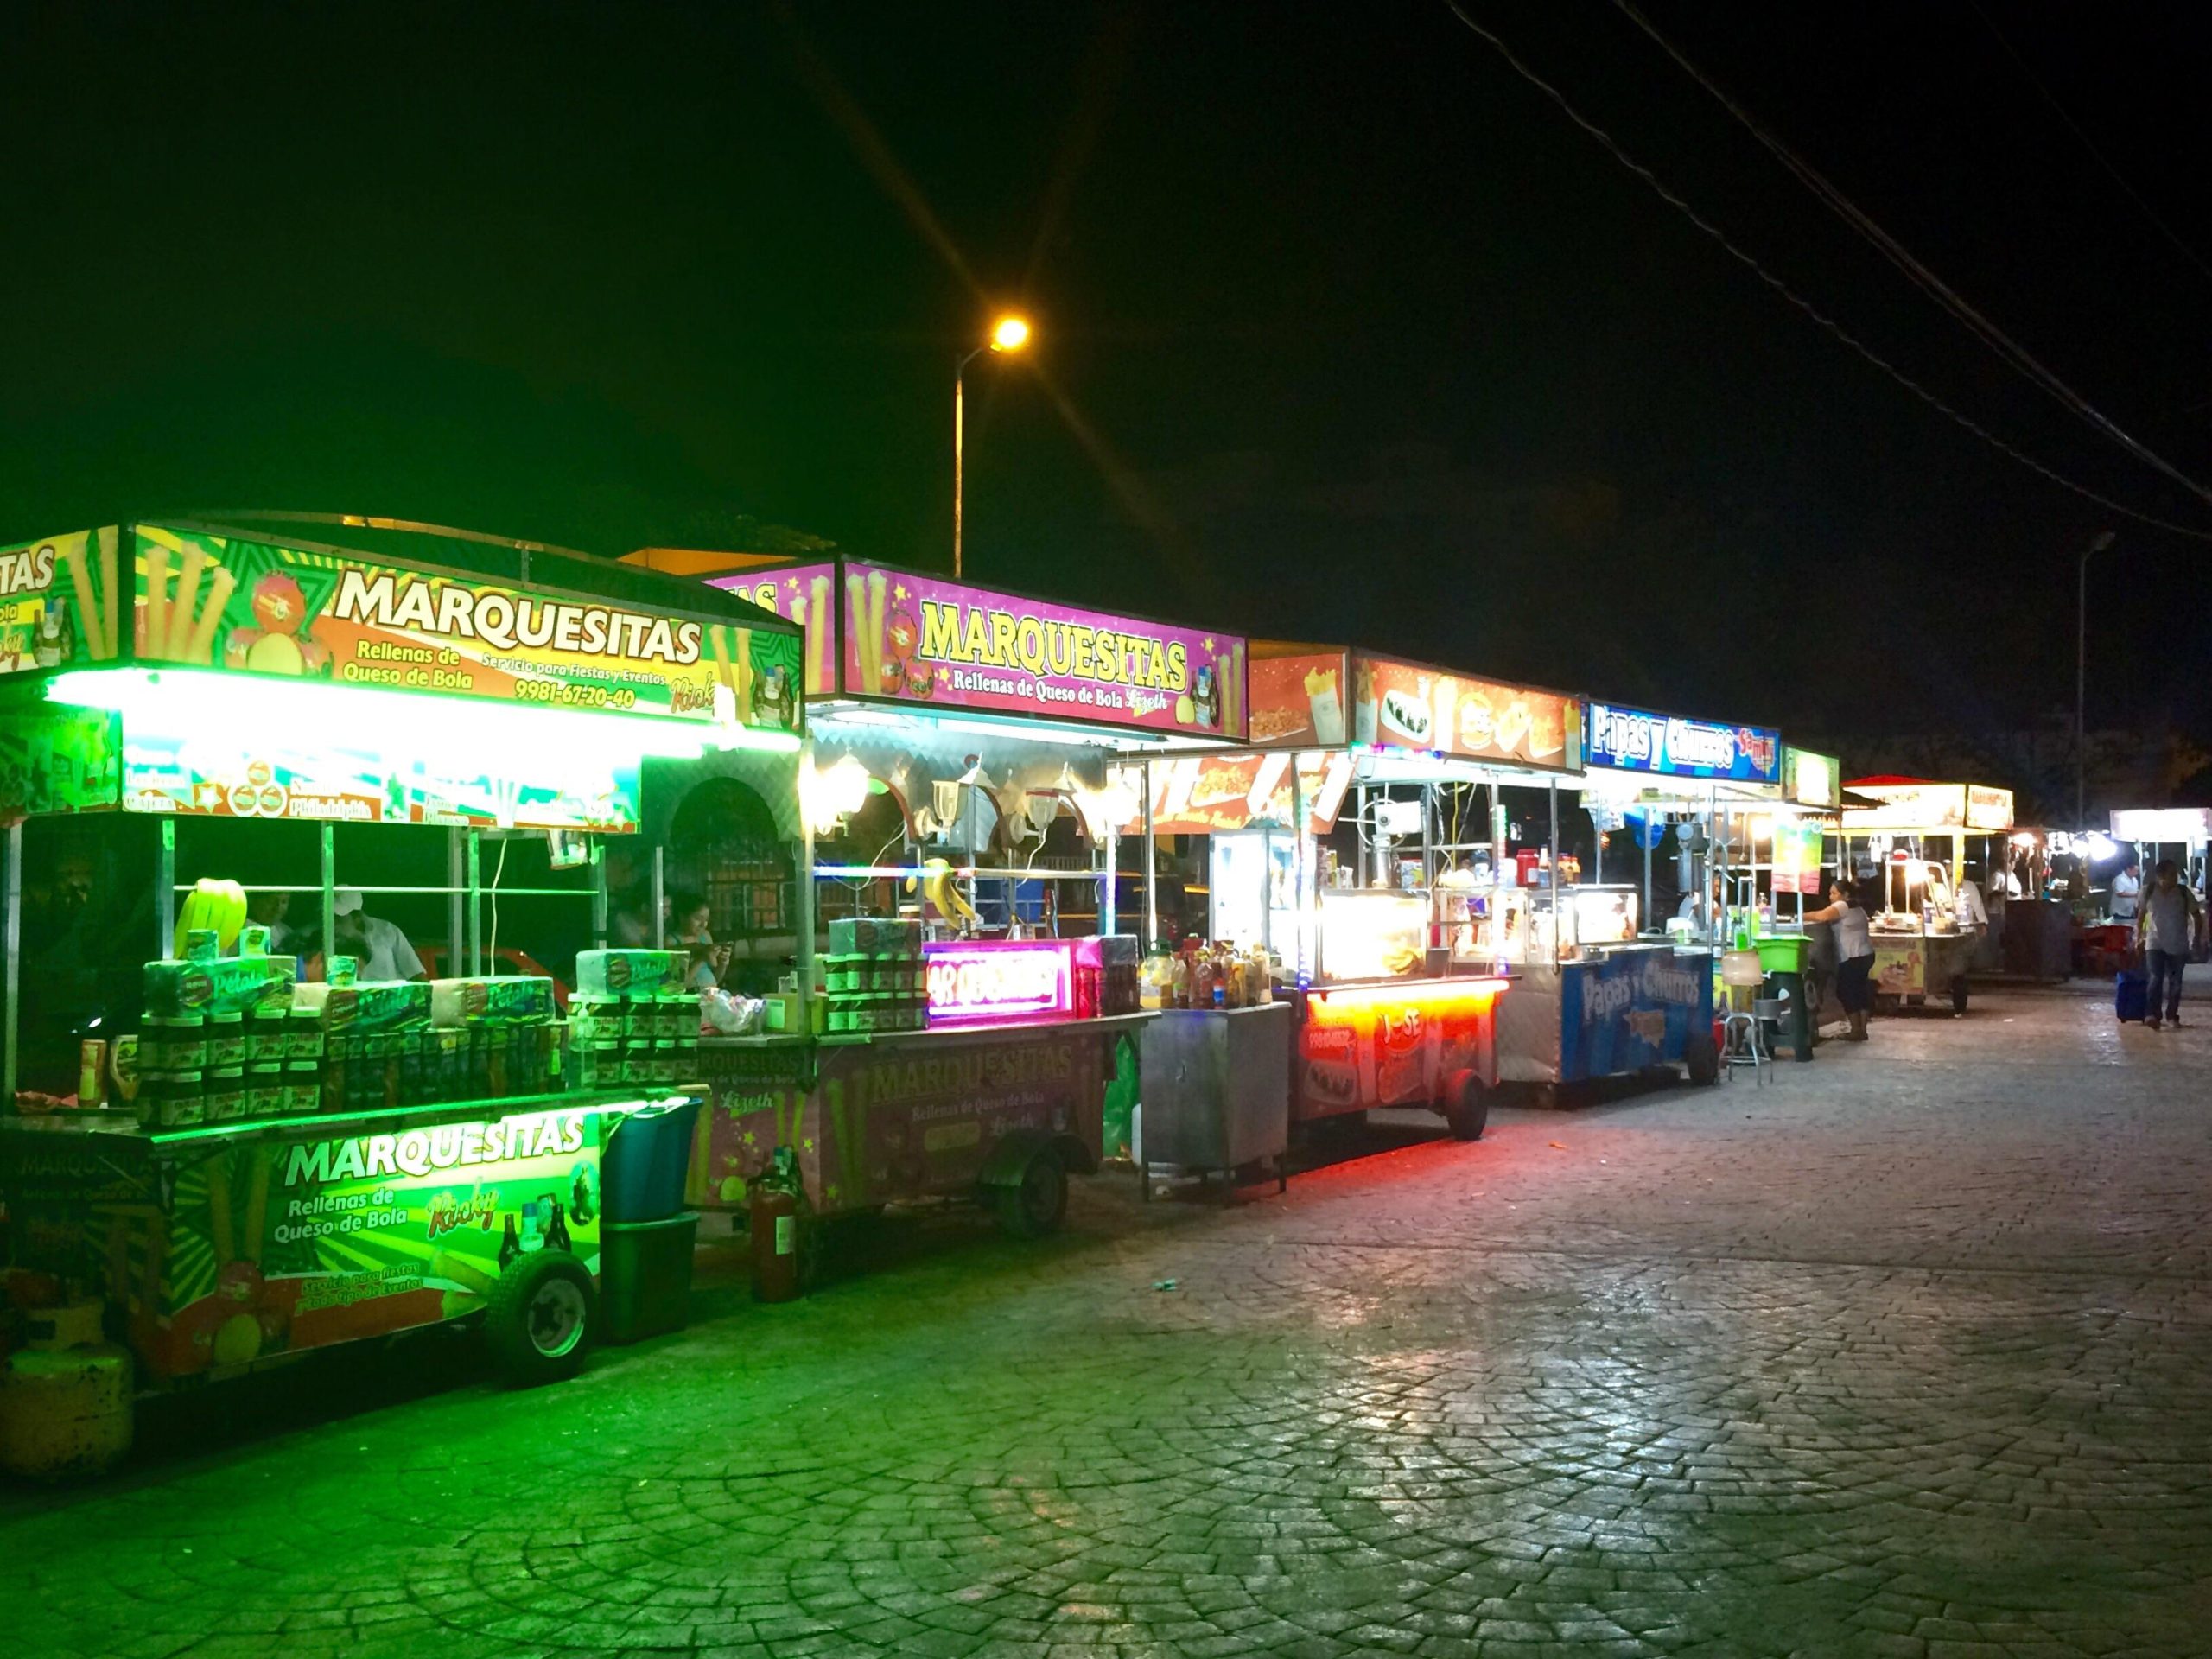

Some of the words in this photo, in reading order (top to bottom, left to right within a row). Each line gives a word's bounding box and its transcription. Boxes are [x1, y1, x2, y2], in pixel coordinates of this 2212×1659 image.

[334, 568, 702, 665] MARQUESITAS
[356, 639, 434, 664] Rellenas
[437, 646, 461, 666] de
[918, 599, 1188, 694] MARQUESITAS
[343, 662, 402, 683] Queso
[405, 666, 429, 686] de
[432, 668, 473, 690] Bola
[482, 652, 533, 673] Servicio
[537, 662, 568, 678] para
[570, 664, 610, 681] Fiestas
[613, 671, 620, 683] y
[622, 670, 667, 686] Eventos
[515, 677, 635, 709] 9981-67-20-40
[954, 670, 1014, 695] Rellenas
[1017, 678, 1033, 696] de
[1036, 681, 1076, 703] Queso
[1078, 687, 1094, 705] de
[1096, 688, 1123, 709] Bola
[1592, 704, 1649, 766] Papas
[1582, 973, 1631, 1024] Papas
[871, 1045, 1072, 1107] MARQUESITAS
[285, 1116, 585, 1187] MARQUESITAS
[289, 1192, 368, 1217] Rellenas
[372, 1186, 395, 1206] de
[427, 1177, 500, 1239] Ricky
[273, 1221, 334, 1244] Queso
[340, 1214, 363, 1234] de
[366, 1206, 408, 1230] Bola
[381, 1263, 419, 1281] fiestas
[381, 1279, 423, 1297] Eventos
